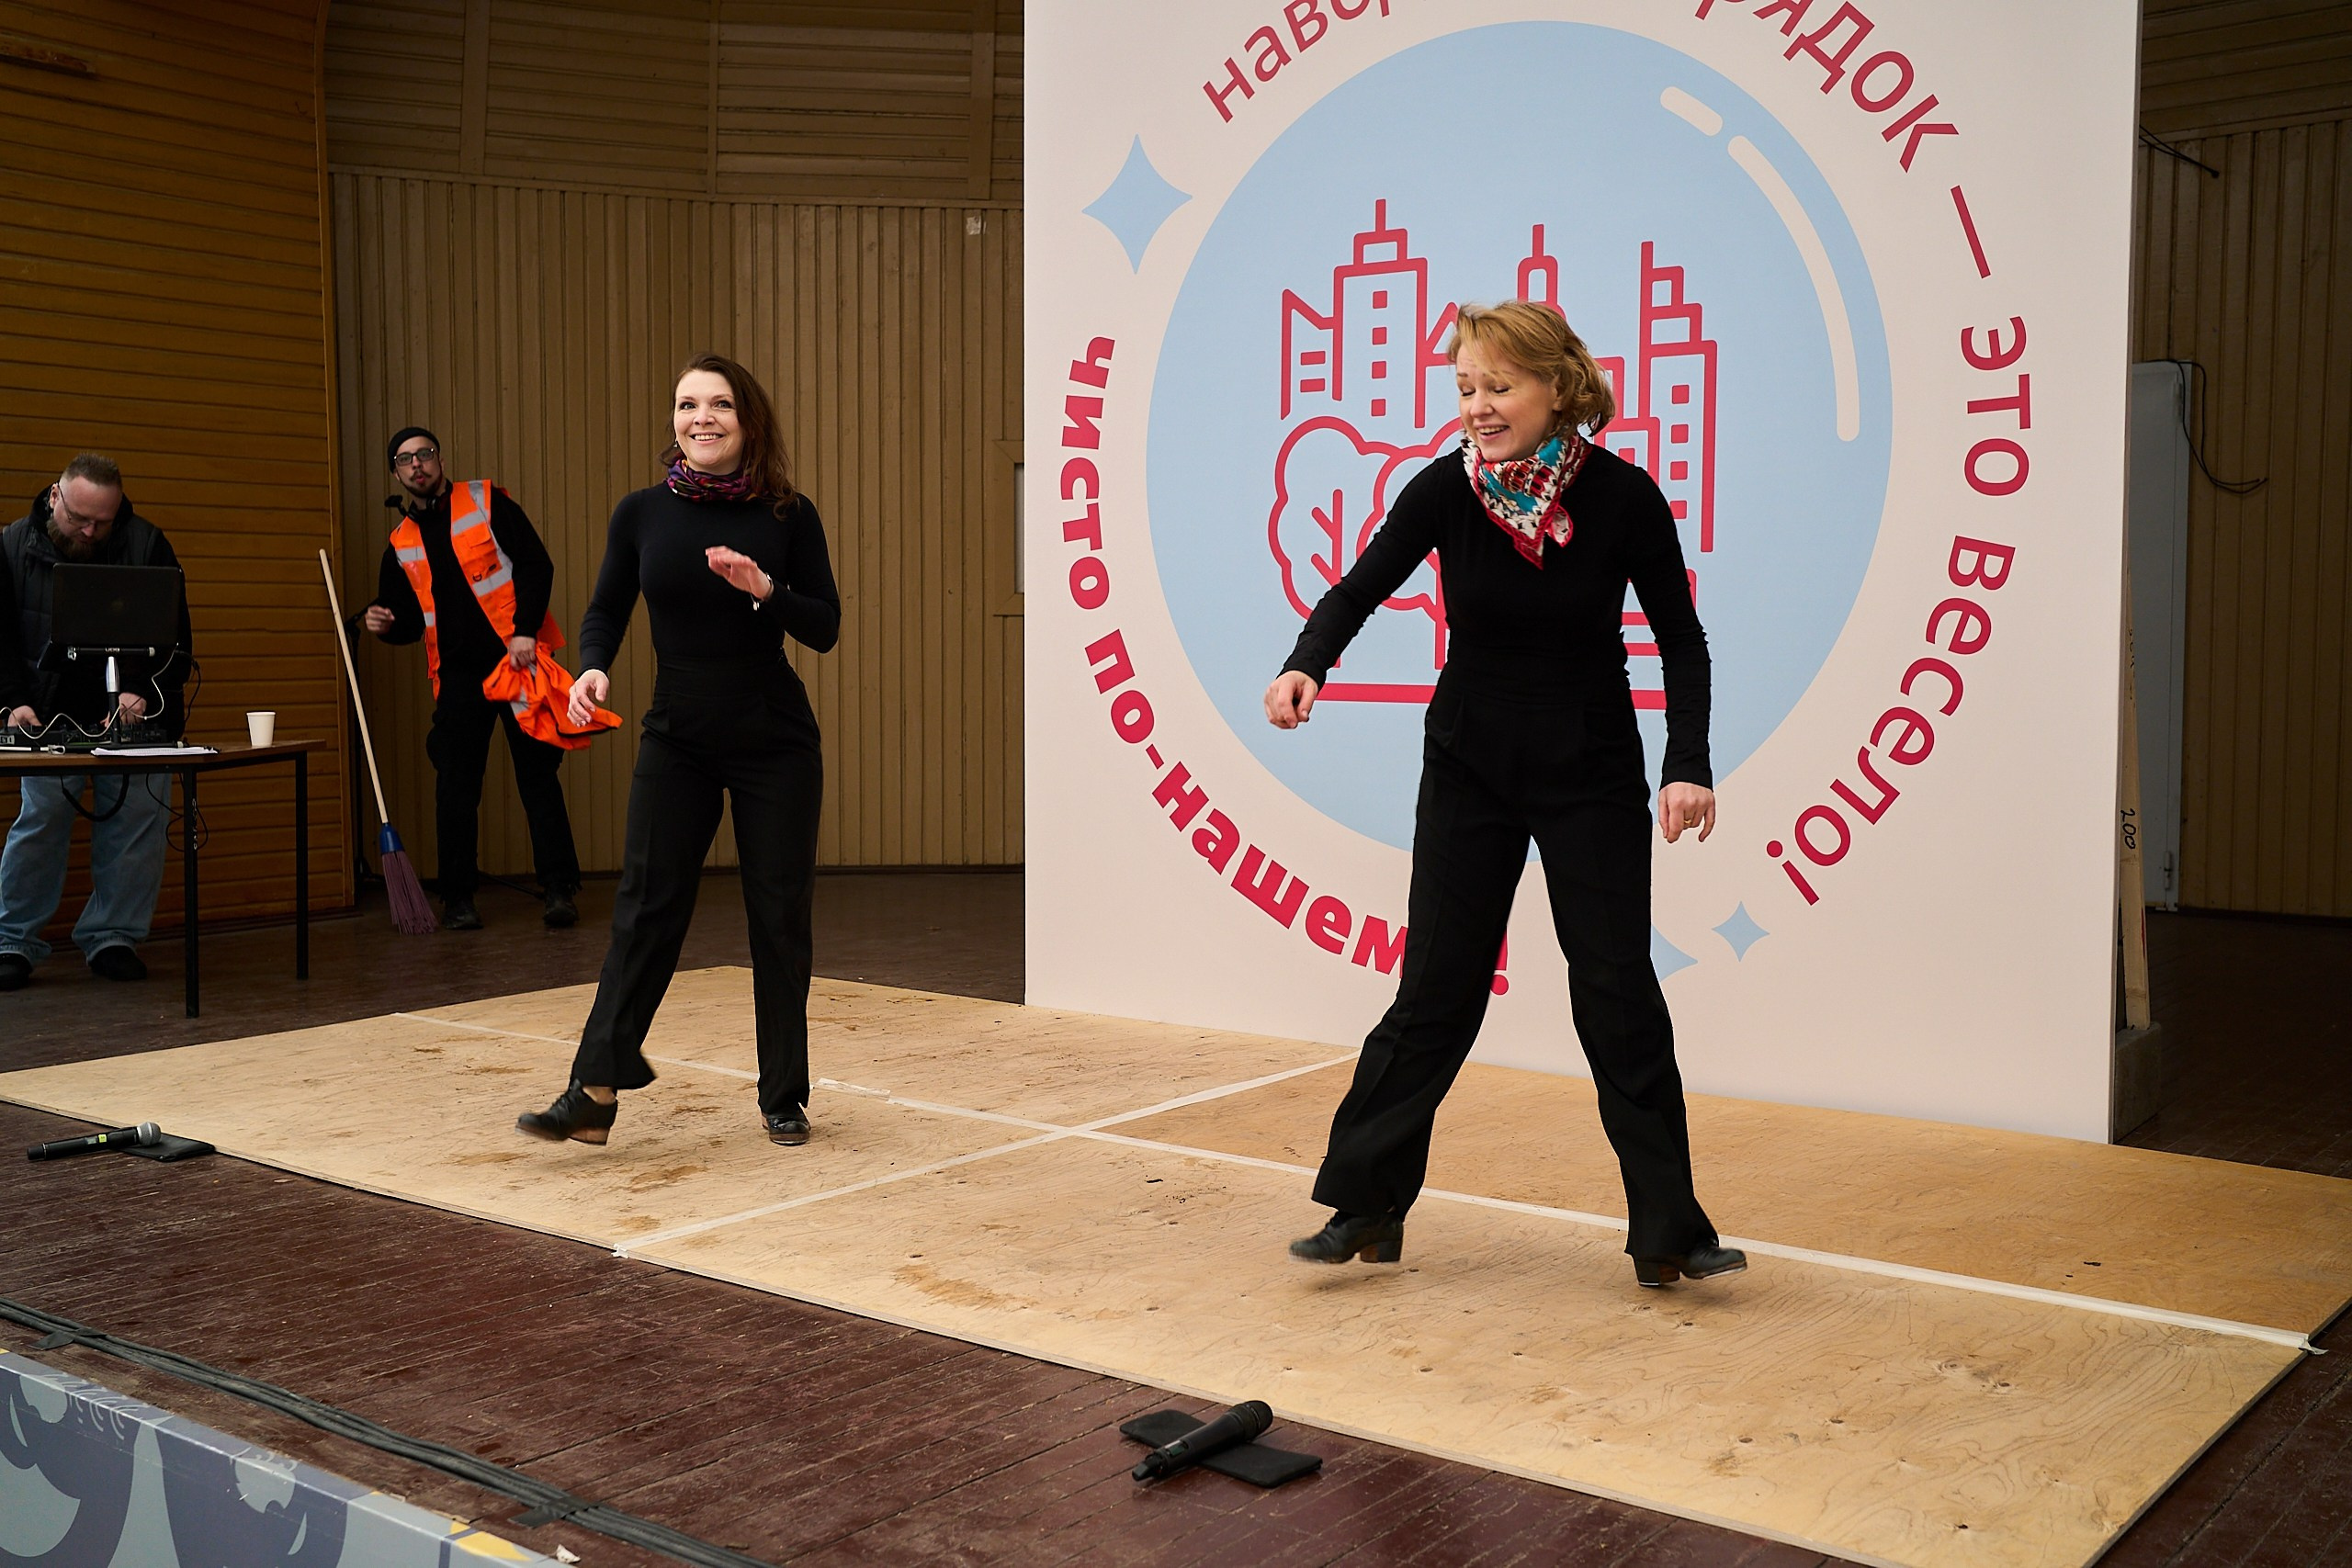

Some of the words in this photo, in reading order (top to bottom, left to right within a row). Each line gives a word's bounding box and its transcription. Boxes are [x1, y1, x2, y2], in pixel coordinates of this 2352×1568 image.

[1060, 336, 1114, 611] чисто
[1961, 316, 2031, 497] это
[1084, 628, 1510, 997] по-нашем!
[1765, 534, 2017, 907] весело!
[2120, 807, 2137, 850] 200
